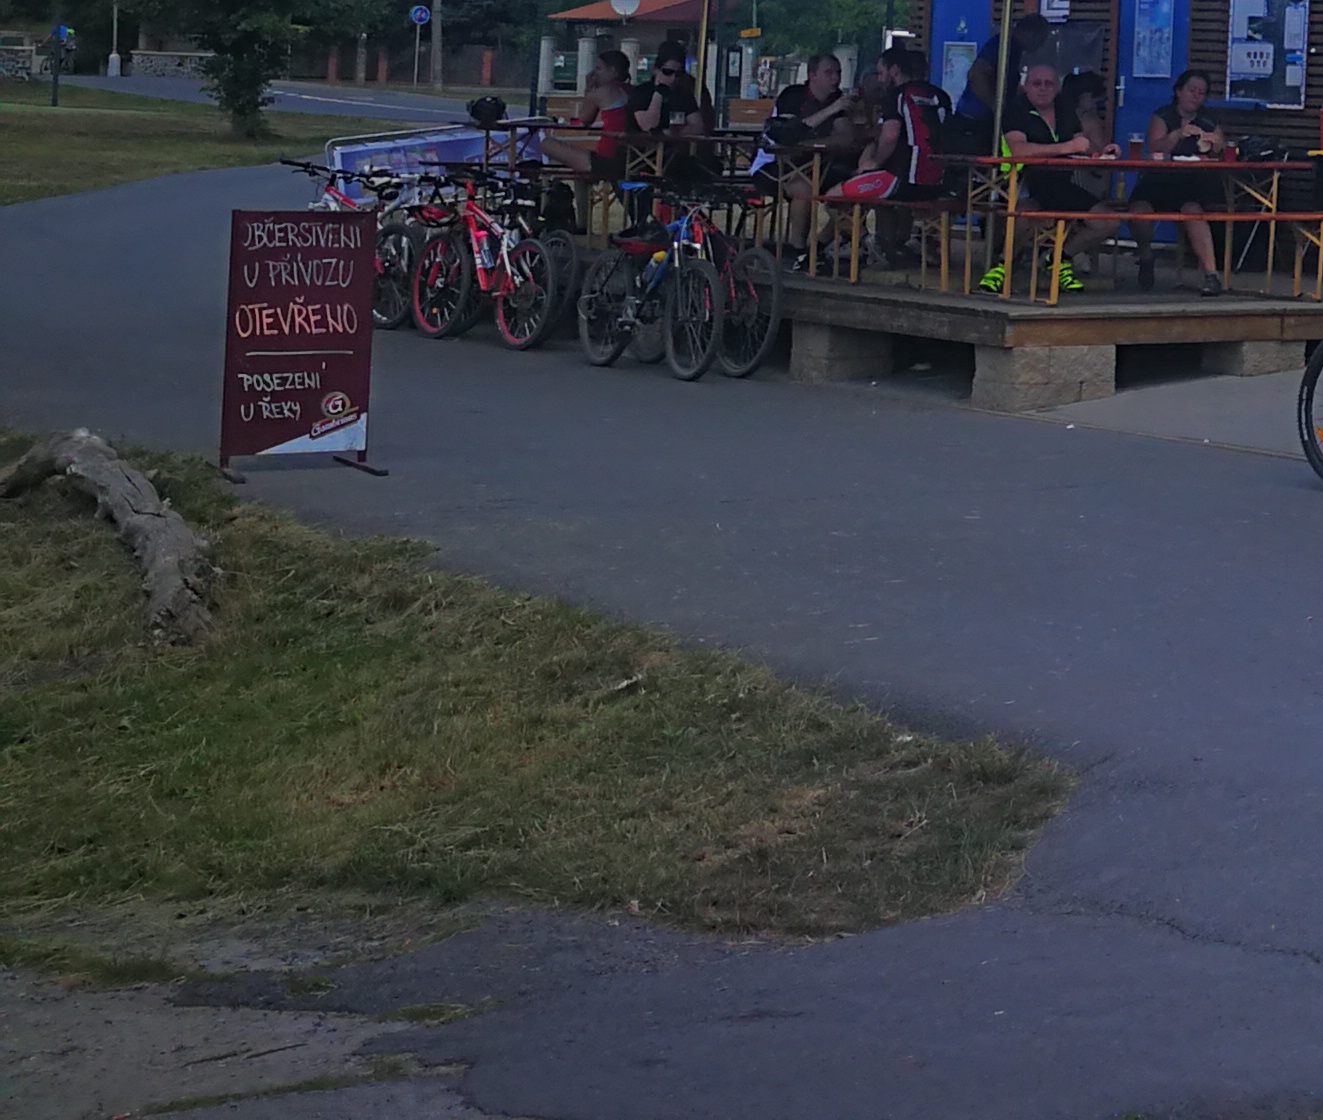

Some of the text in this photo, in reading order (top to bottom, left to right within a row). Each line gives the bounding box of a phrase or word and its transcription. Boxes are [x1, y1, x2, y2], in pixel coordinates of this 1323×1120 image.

[243, 253, 354, 288] U PŘÍVOZU
[235, 296, 358, 338] OTEVŘENO
[237, 362, 327, 392] POSEZENÍ
[240, 395, 301, 422] U ŘEKY
